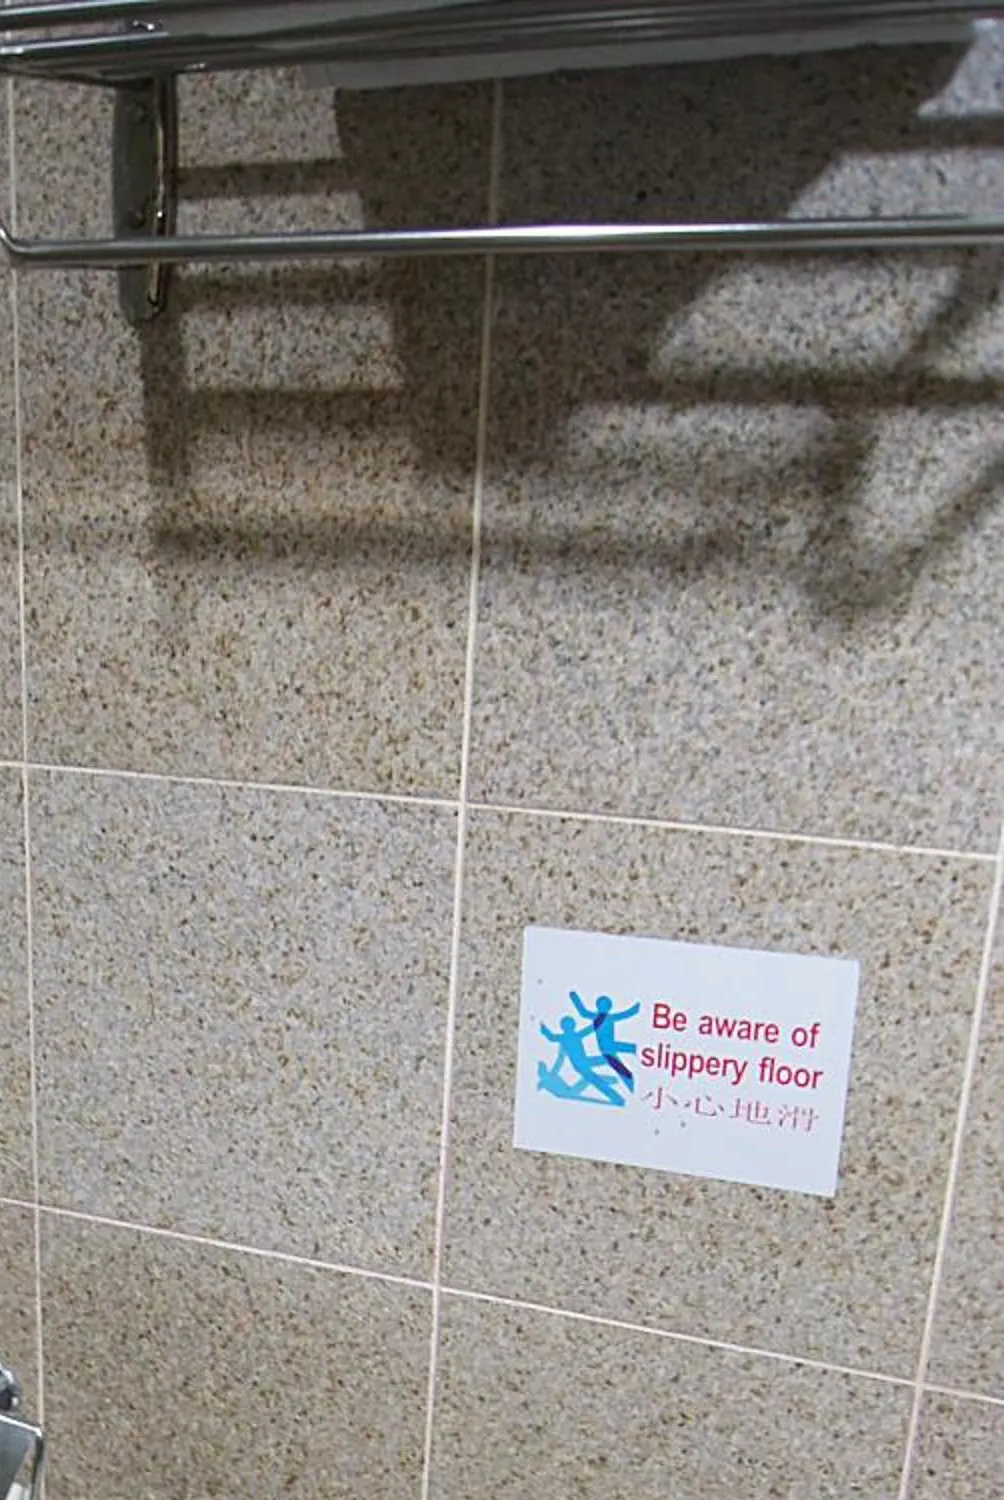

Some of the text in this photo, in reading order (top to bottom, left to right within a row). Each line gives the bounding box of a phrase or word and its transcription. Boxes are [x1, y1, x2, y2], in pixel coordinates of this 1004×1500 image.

[652, 1002, 822, 1049] Be aware of
[640, 1042, 824, 1089] slippery floor
